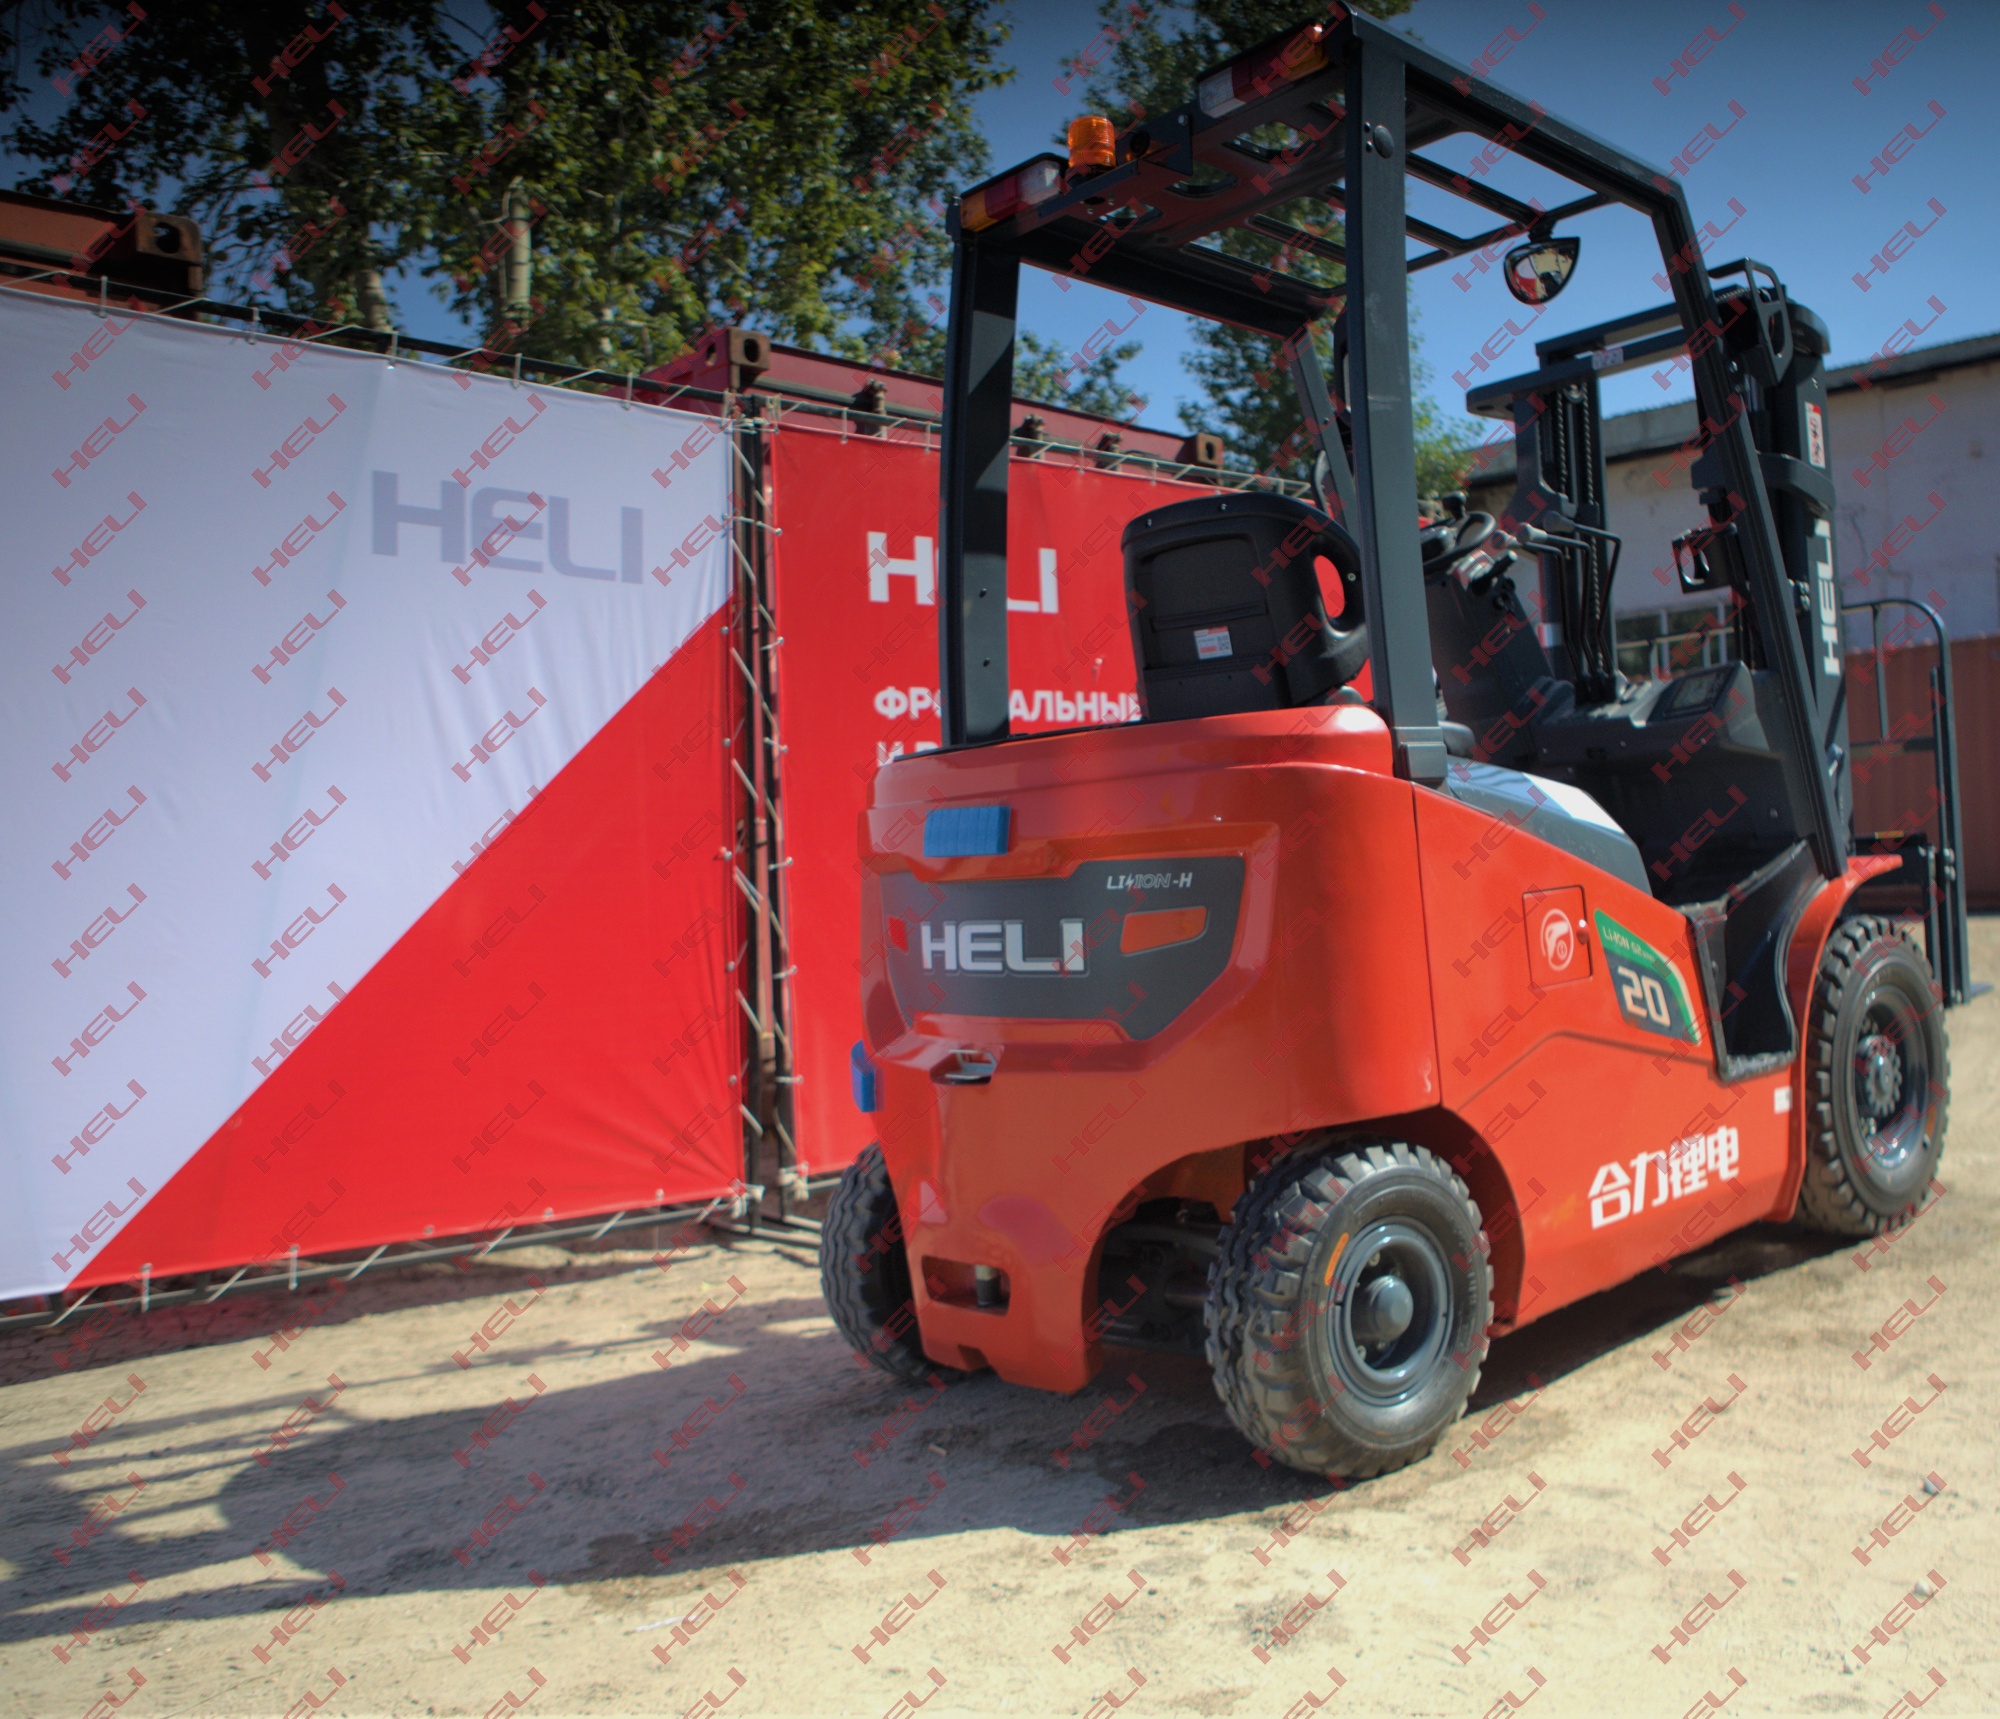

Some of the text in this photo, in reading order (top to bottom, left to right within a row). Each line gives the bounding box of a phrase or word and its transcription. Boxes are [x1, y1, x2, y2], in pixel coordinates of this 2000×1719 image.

[370, 470, 644, 585] HELI
[1814, 518, 1841, 677] HELI
[920, 919, 1086, 974] HELI
[1617, 965, 1671, 1028] 20
[1588, 1125, 1740, 1230] 合力锂电
